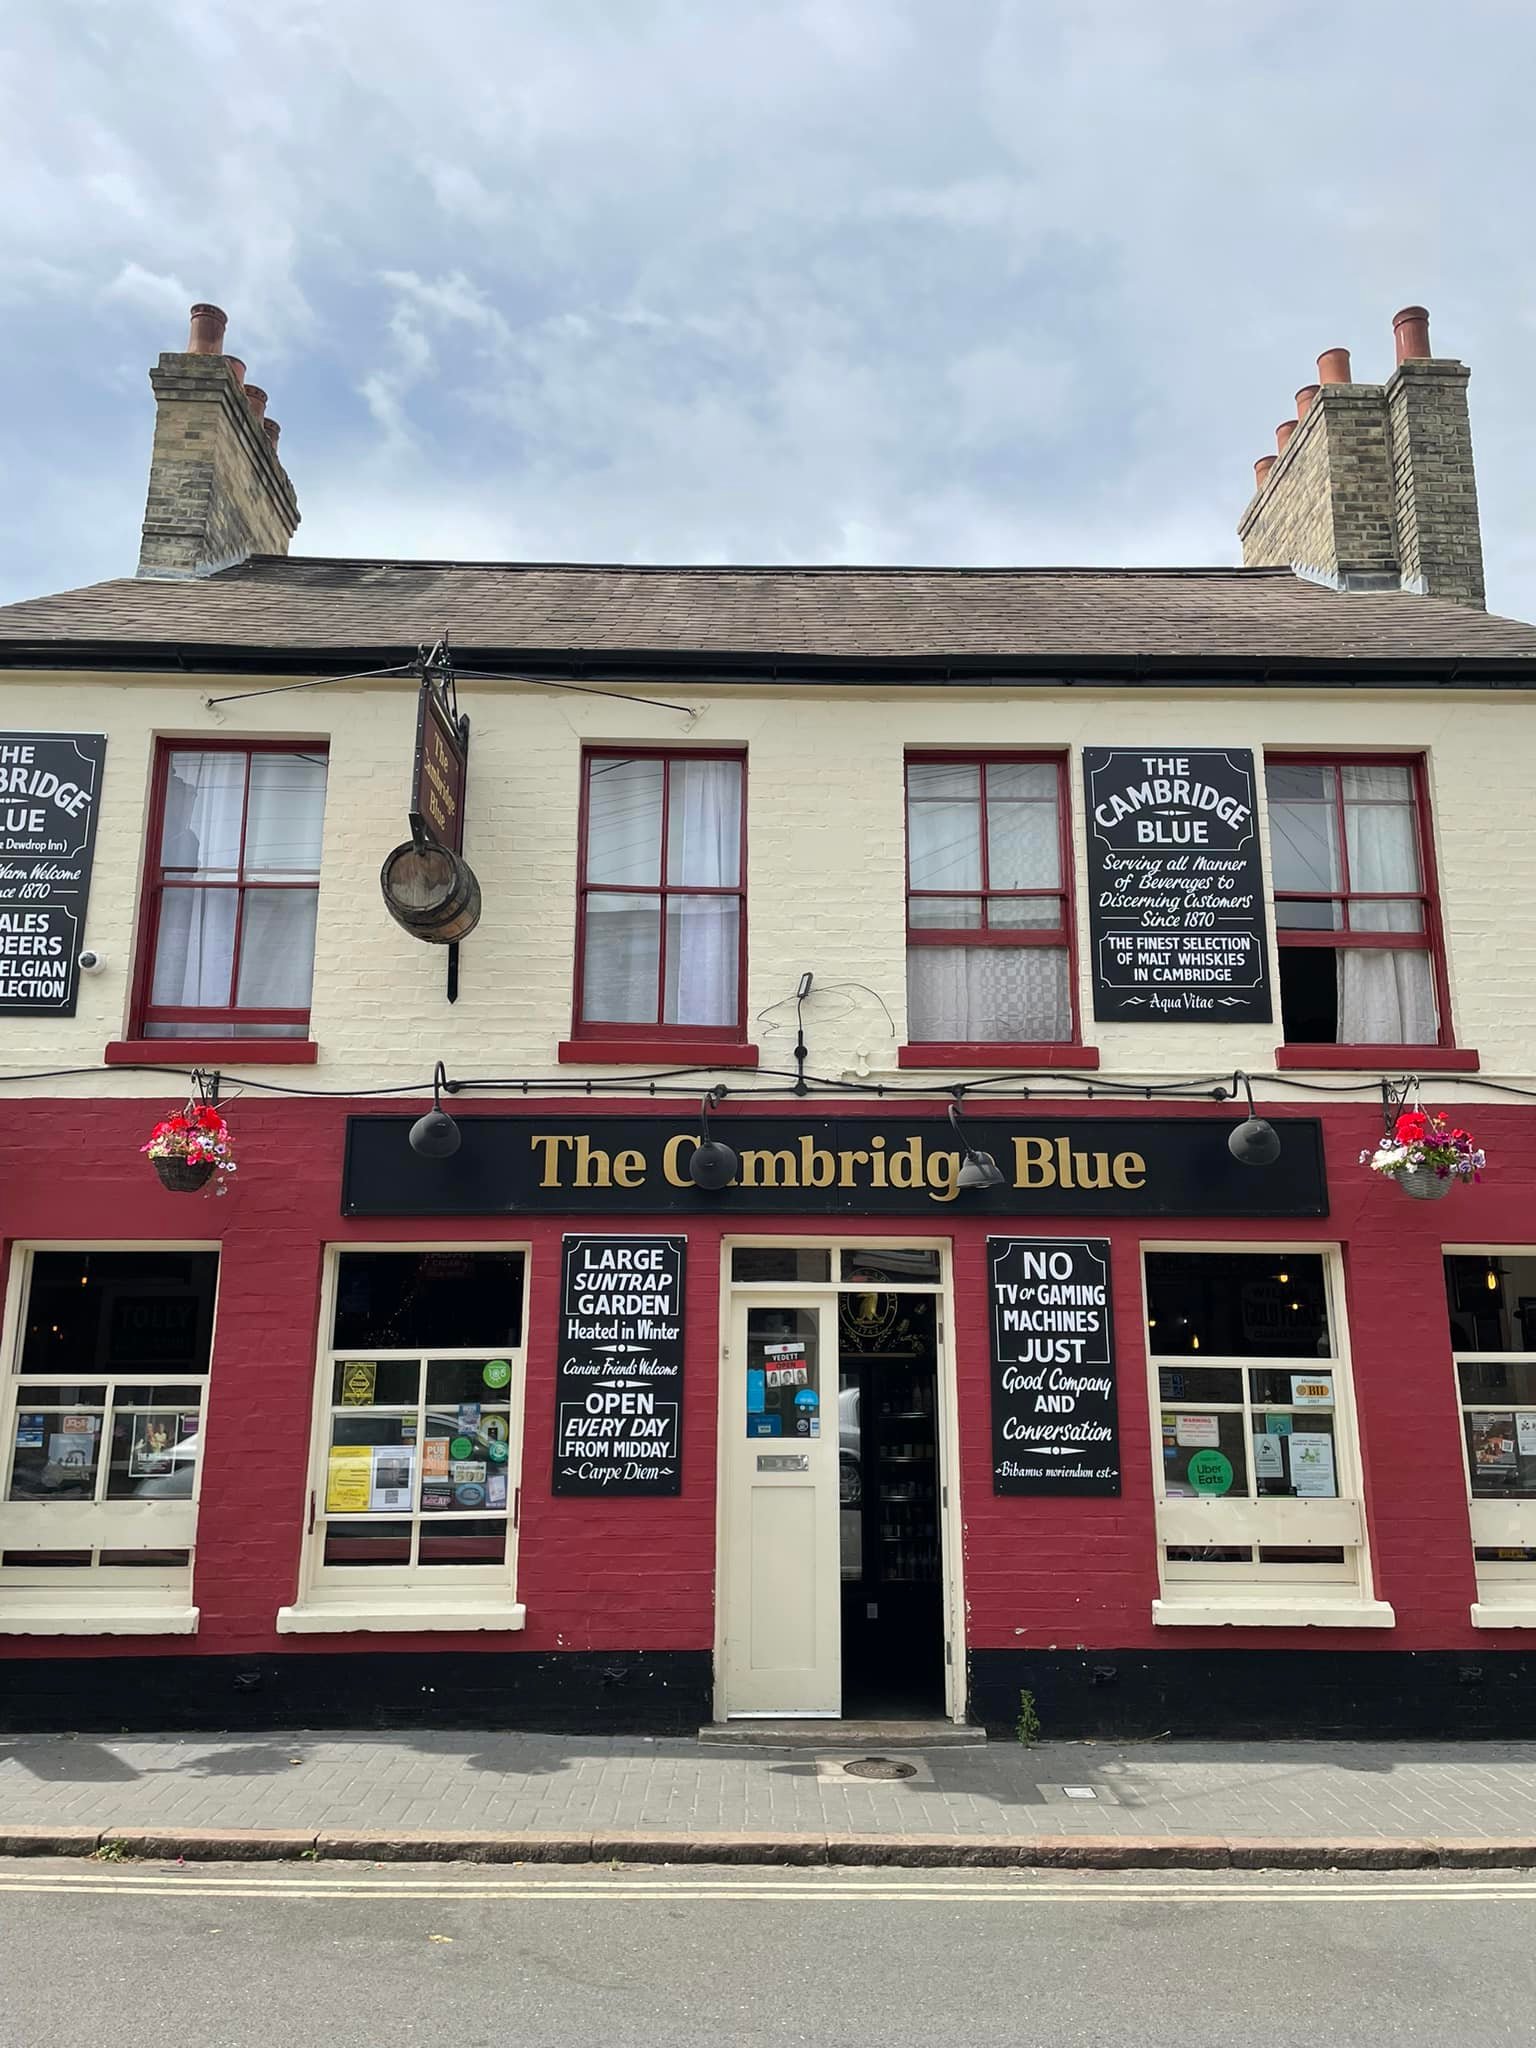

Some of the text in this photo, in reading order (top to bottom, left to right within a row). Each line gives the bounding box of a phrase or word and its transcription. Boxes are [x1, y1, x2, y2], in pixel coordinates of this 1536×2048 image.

[0, 746, 35, 764] HE
[434, 731, 449, 774] The
[1142, 758, 1190, 776] THE
[424, 747, 456, 816] Cambridge
[429, 788, 446, 831] Blue
[1095, 779, 1250, 830] CAMBRIDGE
[1137, 821, 1209, 843] BLUE
[6, 838, 47, 853] Dewdrop
[47, 839, 68, 853] Inn)
[30, 862, 81, 880] Welcome
[1103, 854, 1247, 874] Serving all Manner
[18, 883, 51, 899] 1870
[1115, 874, 1235, 893] of Beverages to
[1099, 892, 1253, 913] Discerning Customers
[0, 913, 50, 933] ALES
[1141, 910, 1215, 928] Since 1870
[1108, 937, 1250, 951] THE FINEST SELECTION
[1117, 952, 1245, 966] OF MALT WHISKIES
[1134, 968, 1232, 981] IN CAMBRIDGE
[1149, 993, 1214, 1012] Aqua Vitae
[531, 1134, 1147, 1202] The Cmbridg Blue
[584, 1249, 664, 1270] LARGE
[1023, 1251, 1073, 1281] NO
[574, 1273, 673, 1291] SUNTRAP
[578, 1294, 670, 1316] GARDEN
[995, 1284, 1106, 1306] TV or GAMING
[567, 1319, 680, 1340] Heated in Winter
[1003, 1310, 1100, 1332] MACHINES
[1018, 1339, 1086, 1364] JUST
[563, 1357, 679, 1376] Canine Friends Welcome
[1002, 1366, 1112, 1400] Good Company
[585, 1392, 654, 1415] OPEN
[1034, 1395, 1075, 1413] AND
[565, 1418, 670, 1437] EVERY DAY
[1003, 1417, 1112, 1442] Conversation
[565, 1441, 670, 1458] FROM MIDDAY
[578, 1462, 660, 1486] Carpe Diem
[1002, 1461, 1043, 1477] Bibamus
[1197, 1465, 1221, 1474] Uber
[1199, 1475, 1223, 1485] Eats
